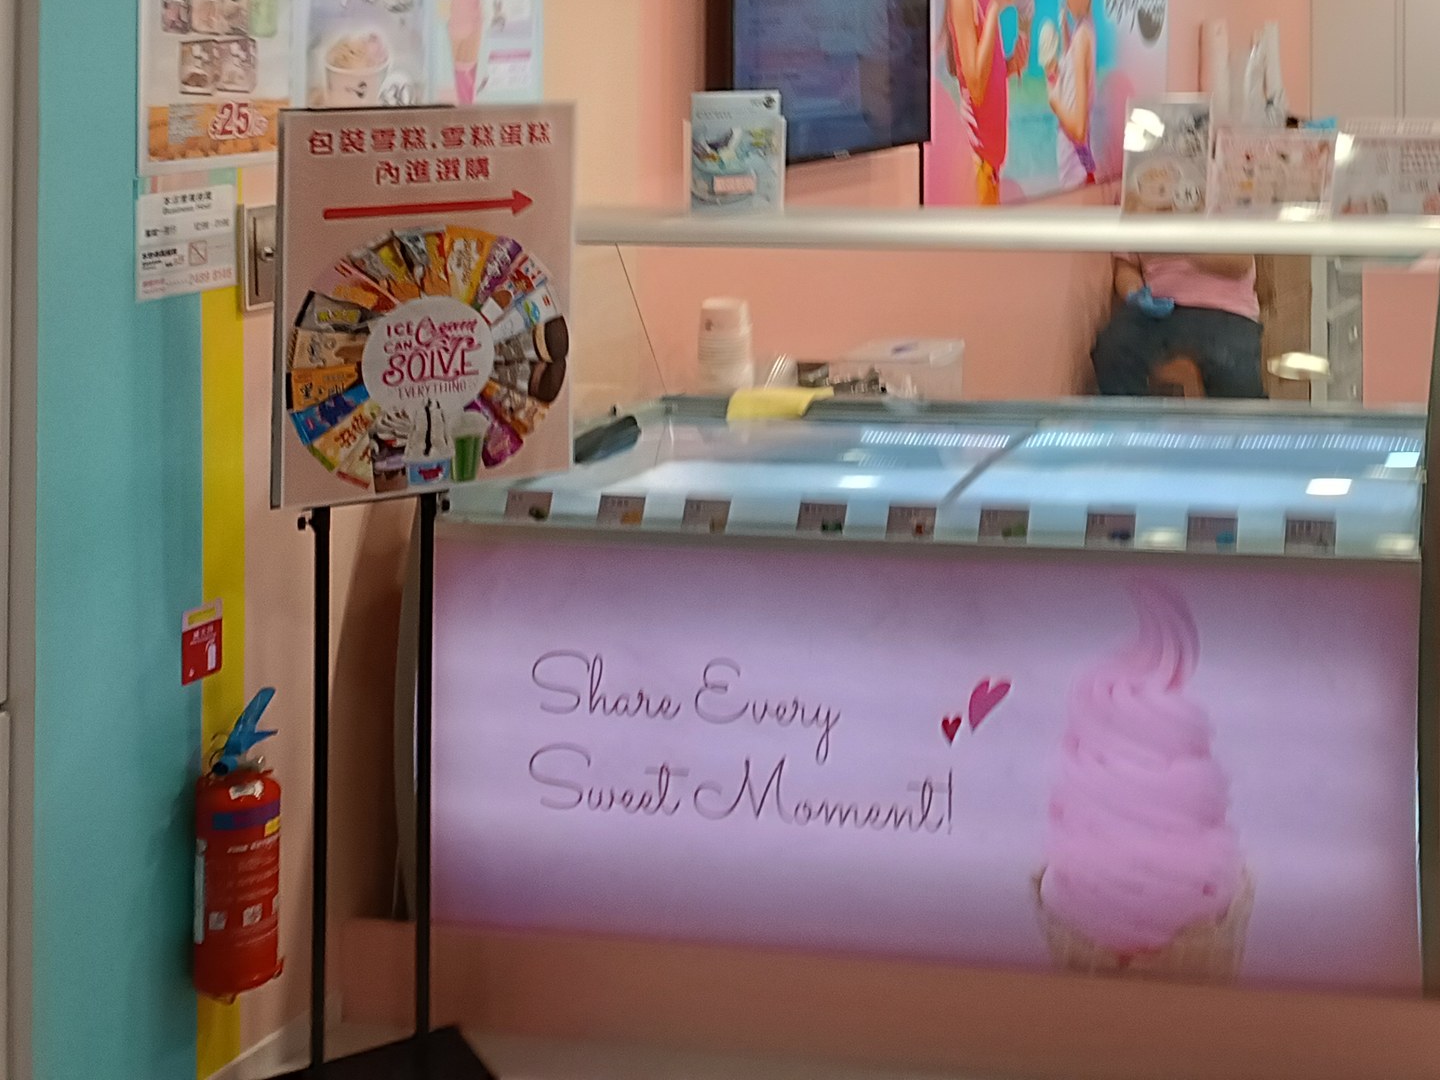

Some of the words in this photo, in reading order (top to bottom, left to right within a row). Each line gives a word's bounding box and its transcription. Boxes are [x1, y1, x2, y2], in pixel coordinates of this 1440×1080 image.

[384, 340, 413, 354] CAN
[386, 321, 414, 338] ICE
[415, 316, 478, 348] Cream
[382, 337, 482, 387] SOLVE
[397, 380, 468, 400] EVERYTHING
[530, 649, 682, 721] Share
[694, 657, 841, 765] Every
[528, 742, 690, 817] Sweet
[693, 755, 954, 835] Moment!
